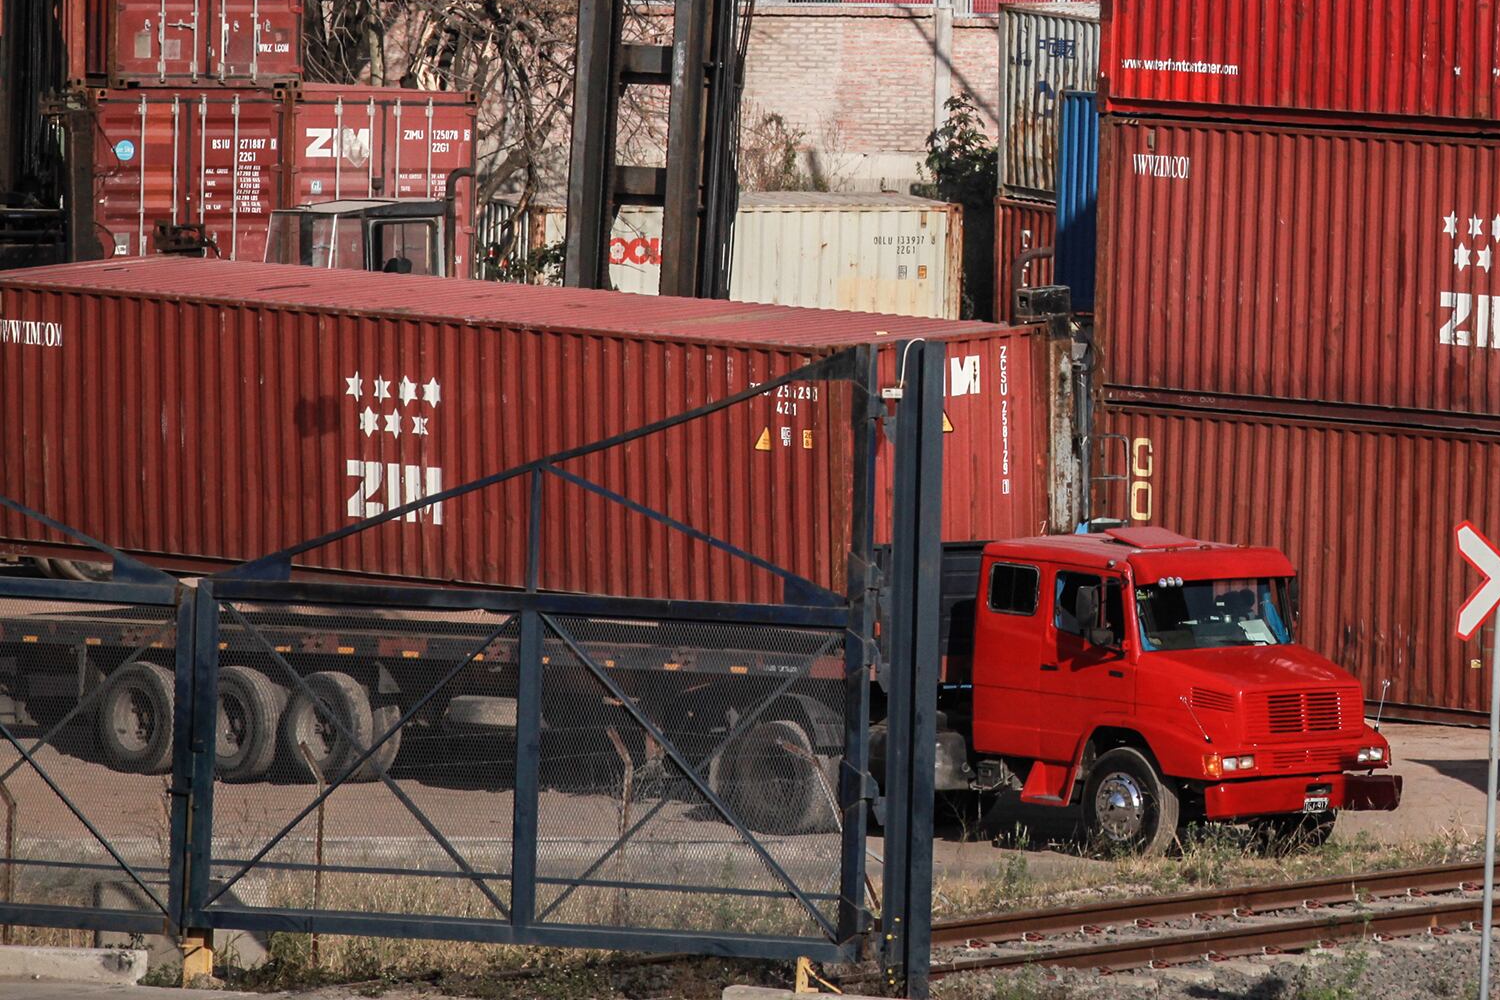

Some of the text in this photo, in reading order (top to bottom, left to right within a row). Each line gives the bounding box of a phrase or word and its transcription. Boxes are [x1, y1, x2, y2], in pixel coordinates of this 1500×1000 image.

[212, 138, 231, 149] BSIU
[239, 138, 266, 149] 271887
[305, 128, 371, 158] ZIM
[404, 130, 424, 140] ZIMU
[433, 129, 458, 140] 125078
[239, 151, 256, 162] 22G1
[432, 142, 449, 153] 22G1
[1000, 345, 1008, 396] ZCSU
[1001, 400, 1009, 475] 258129
[347, 459, 443, 525] ZIM
